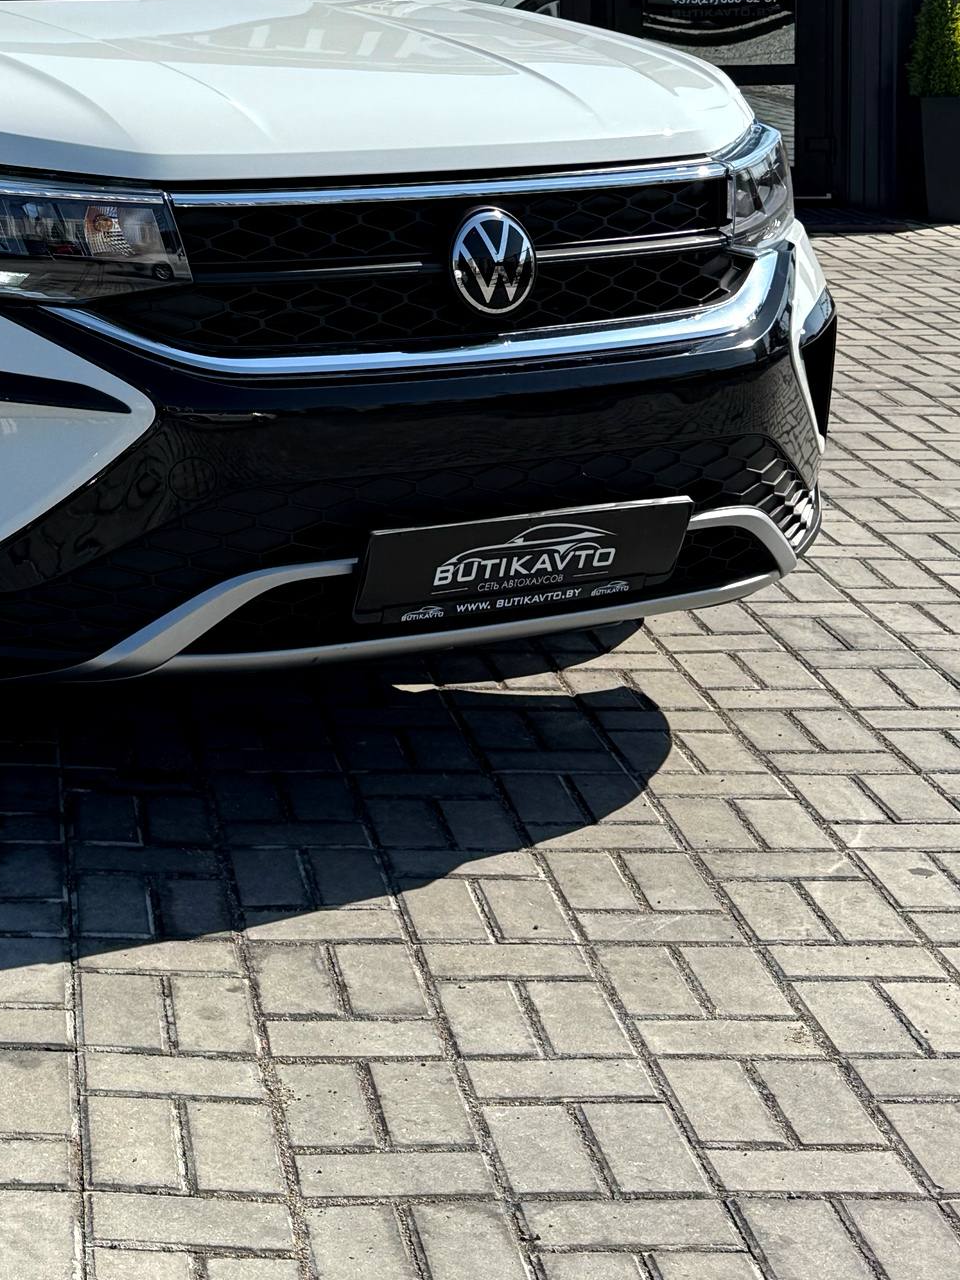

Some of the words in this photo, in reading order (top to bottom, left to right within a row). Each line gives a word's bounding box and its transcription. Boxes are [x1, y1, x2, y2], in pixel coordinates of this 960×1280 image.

[433, 547, 616, 586] BUTIKAVTO
[477, 581, 500, 592] СЕТЬ
[501, 574, 564, 589] АВТОХАУСОВ
[456, 601, 491, 612] WWW.
[496, 588, 582, 608] BUTIKAVTO.BY
